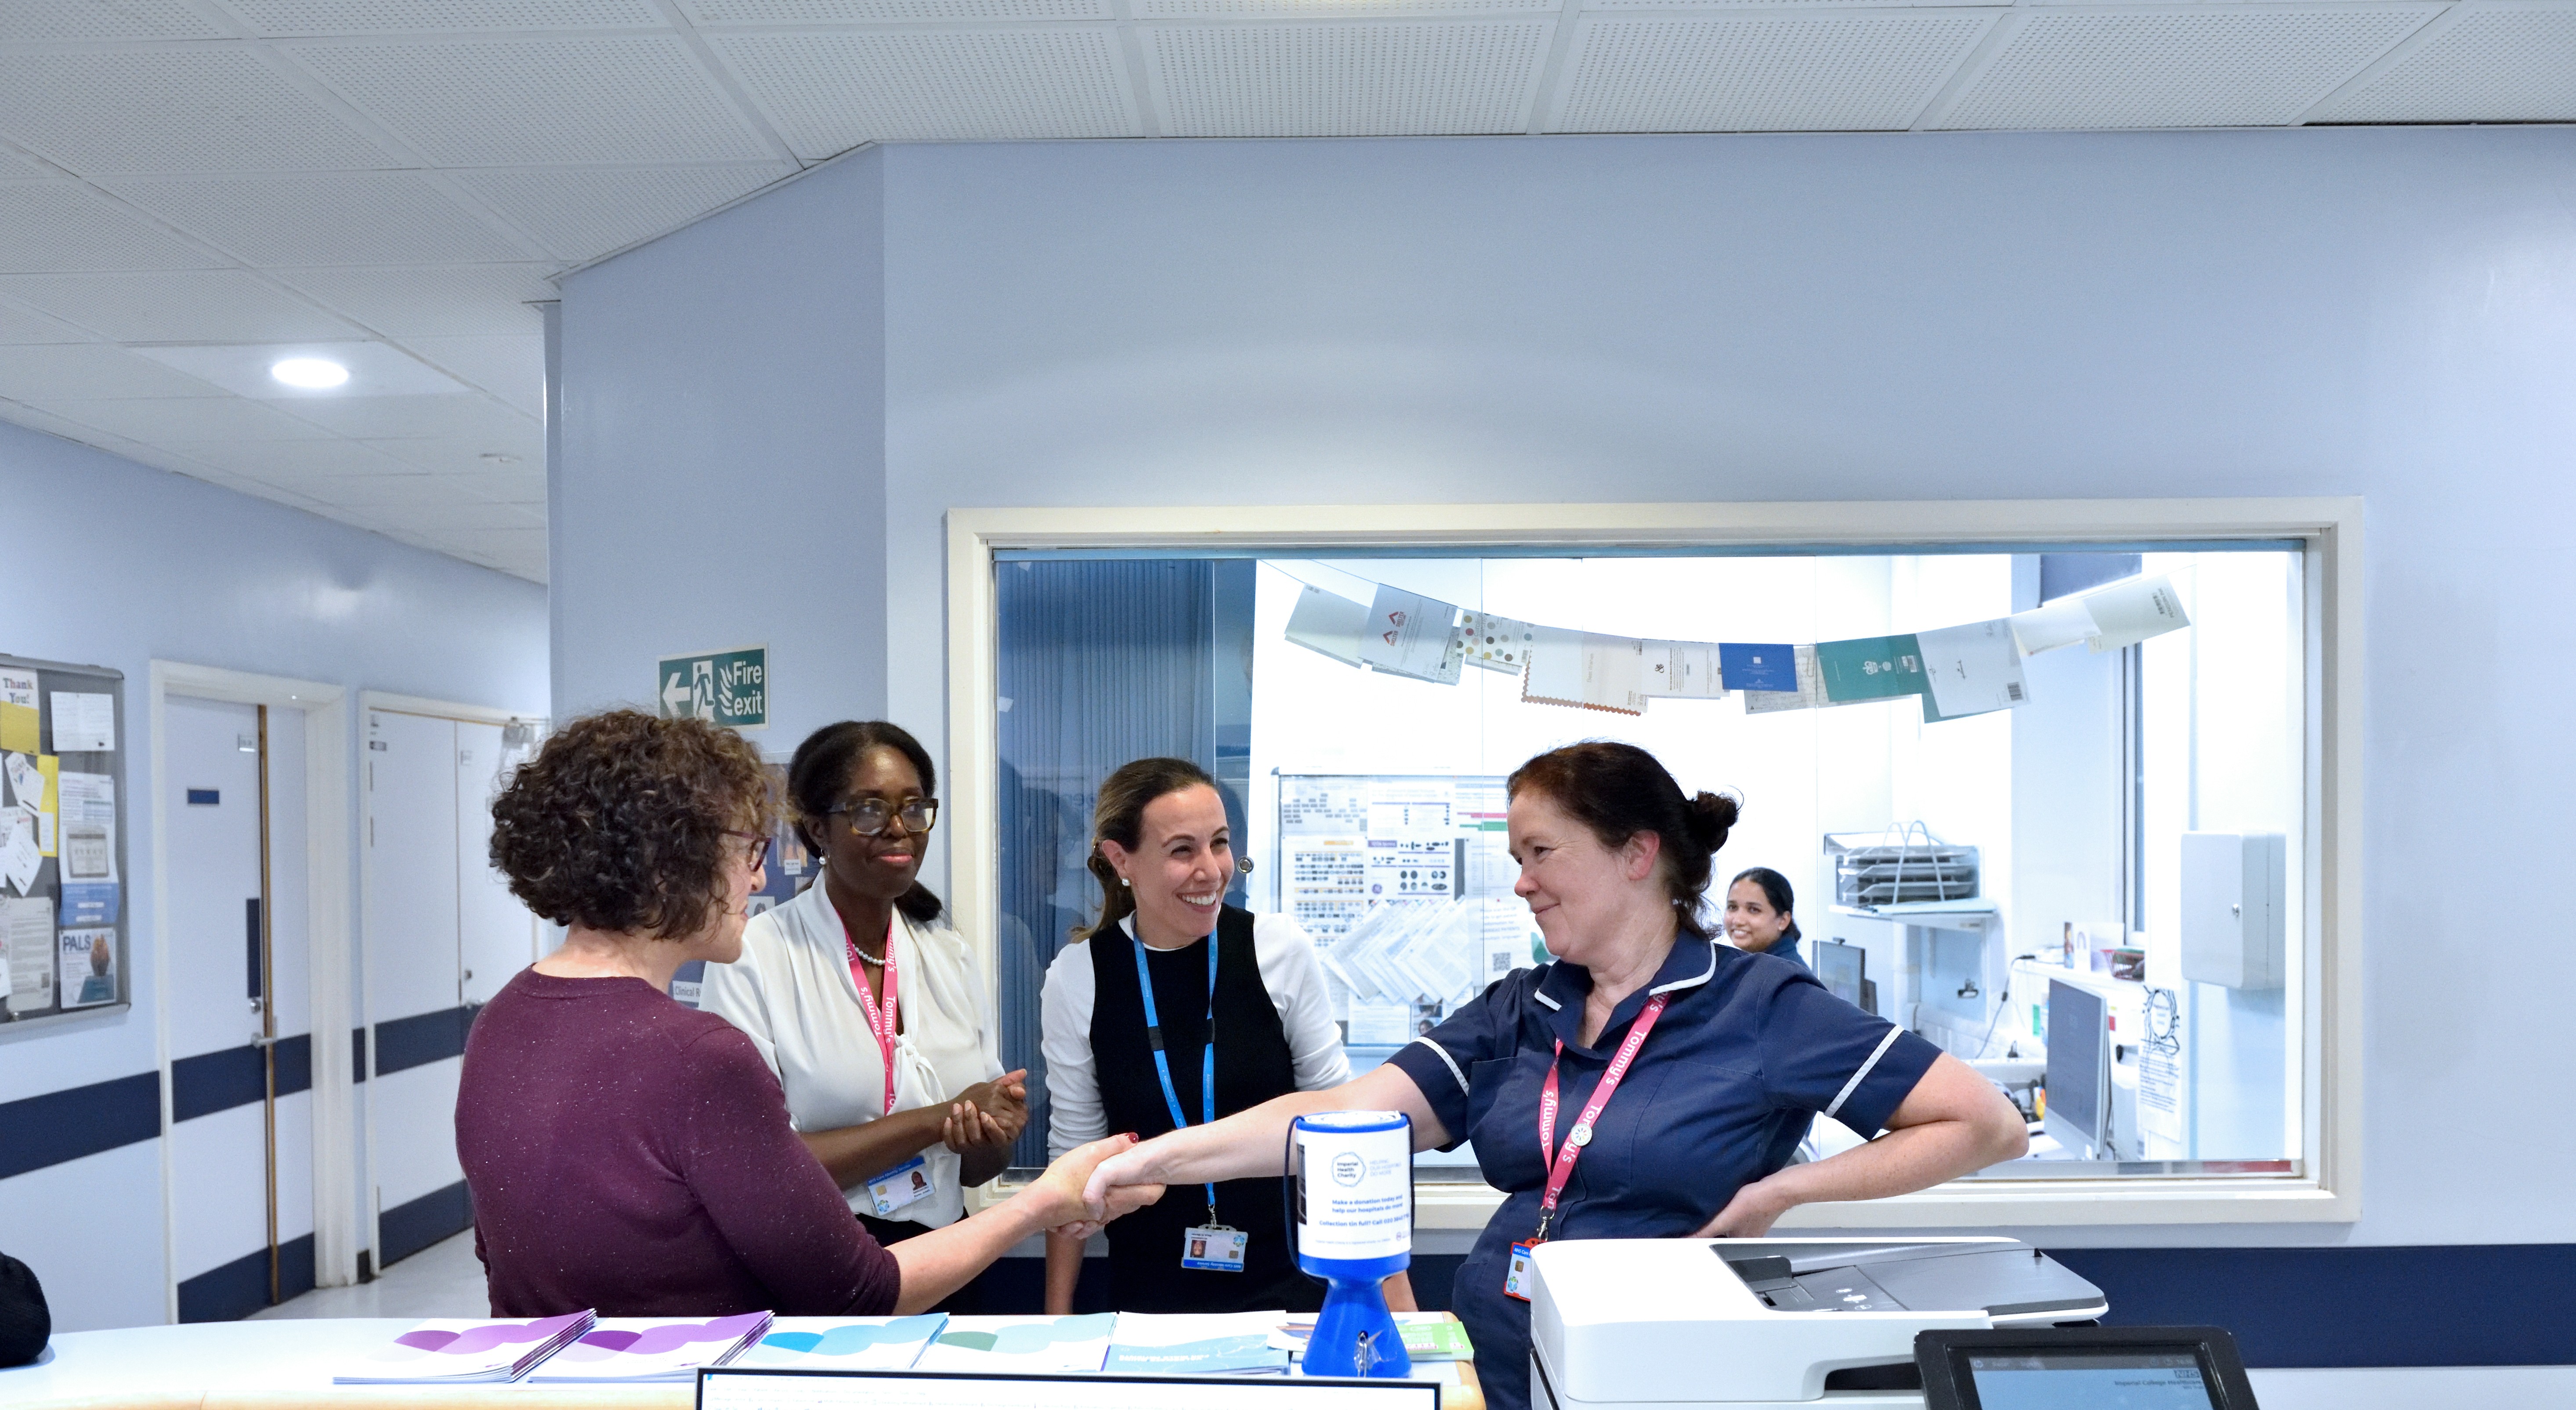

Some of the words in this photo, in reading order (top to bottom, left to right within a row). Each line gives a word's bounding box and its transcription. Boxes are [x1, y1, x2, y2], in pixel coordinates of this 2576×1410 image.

[1395, 611, 1404, 627] SHELTER
[1390, 630, 1398, 646] SHELTER
[734, 661, 762, 686] Fire
[3, 678, 33, 690] Thank
[9, 692, 30, 704] You!
[734, 690, 762, 716] exit
[63, 935, 91, 951] PALS
[675, 986, 695, 996] Clinical
[861, 987, 881, 1037] Tommy's
[885, 996, 896, 1043] Tommy's
[1606, 1030, 1647, 1086] Tommy's
[1541, 1090, 1557, 1151] Tommy's
[2141, 1379, 2165, 1387] College
[2167, 1377, 2202, 1388] Healthcare
